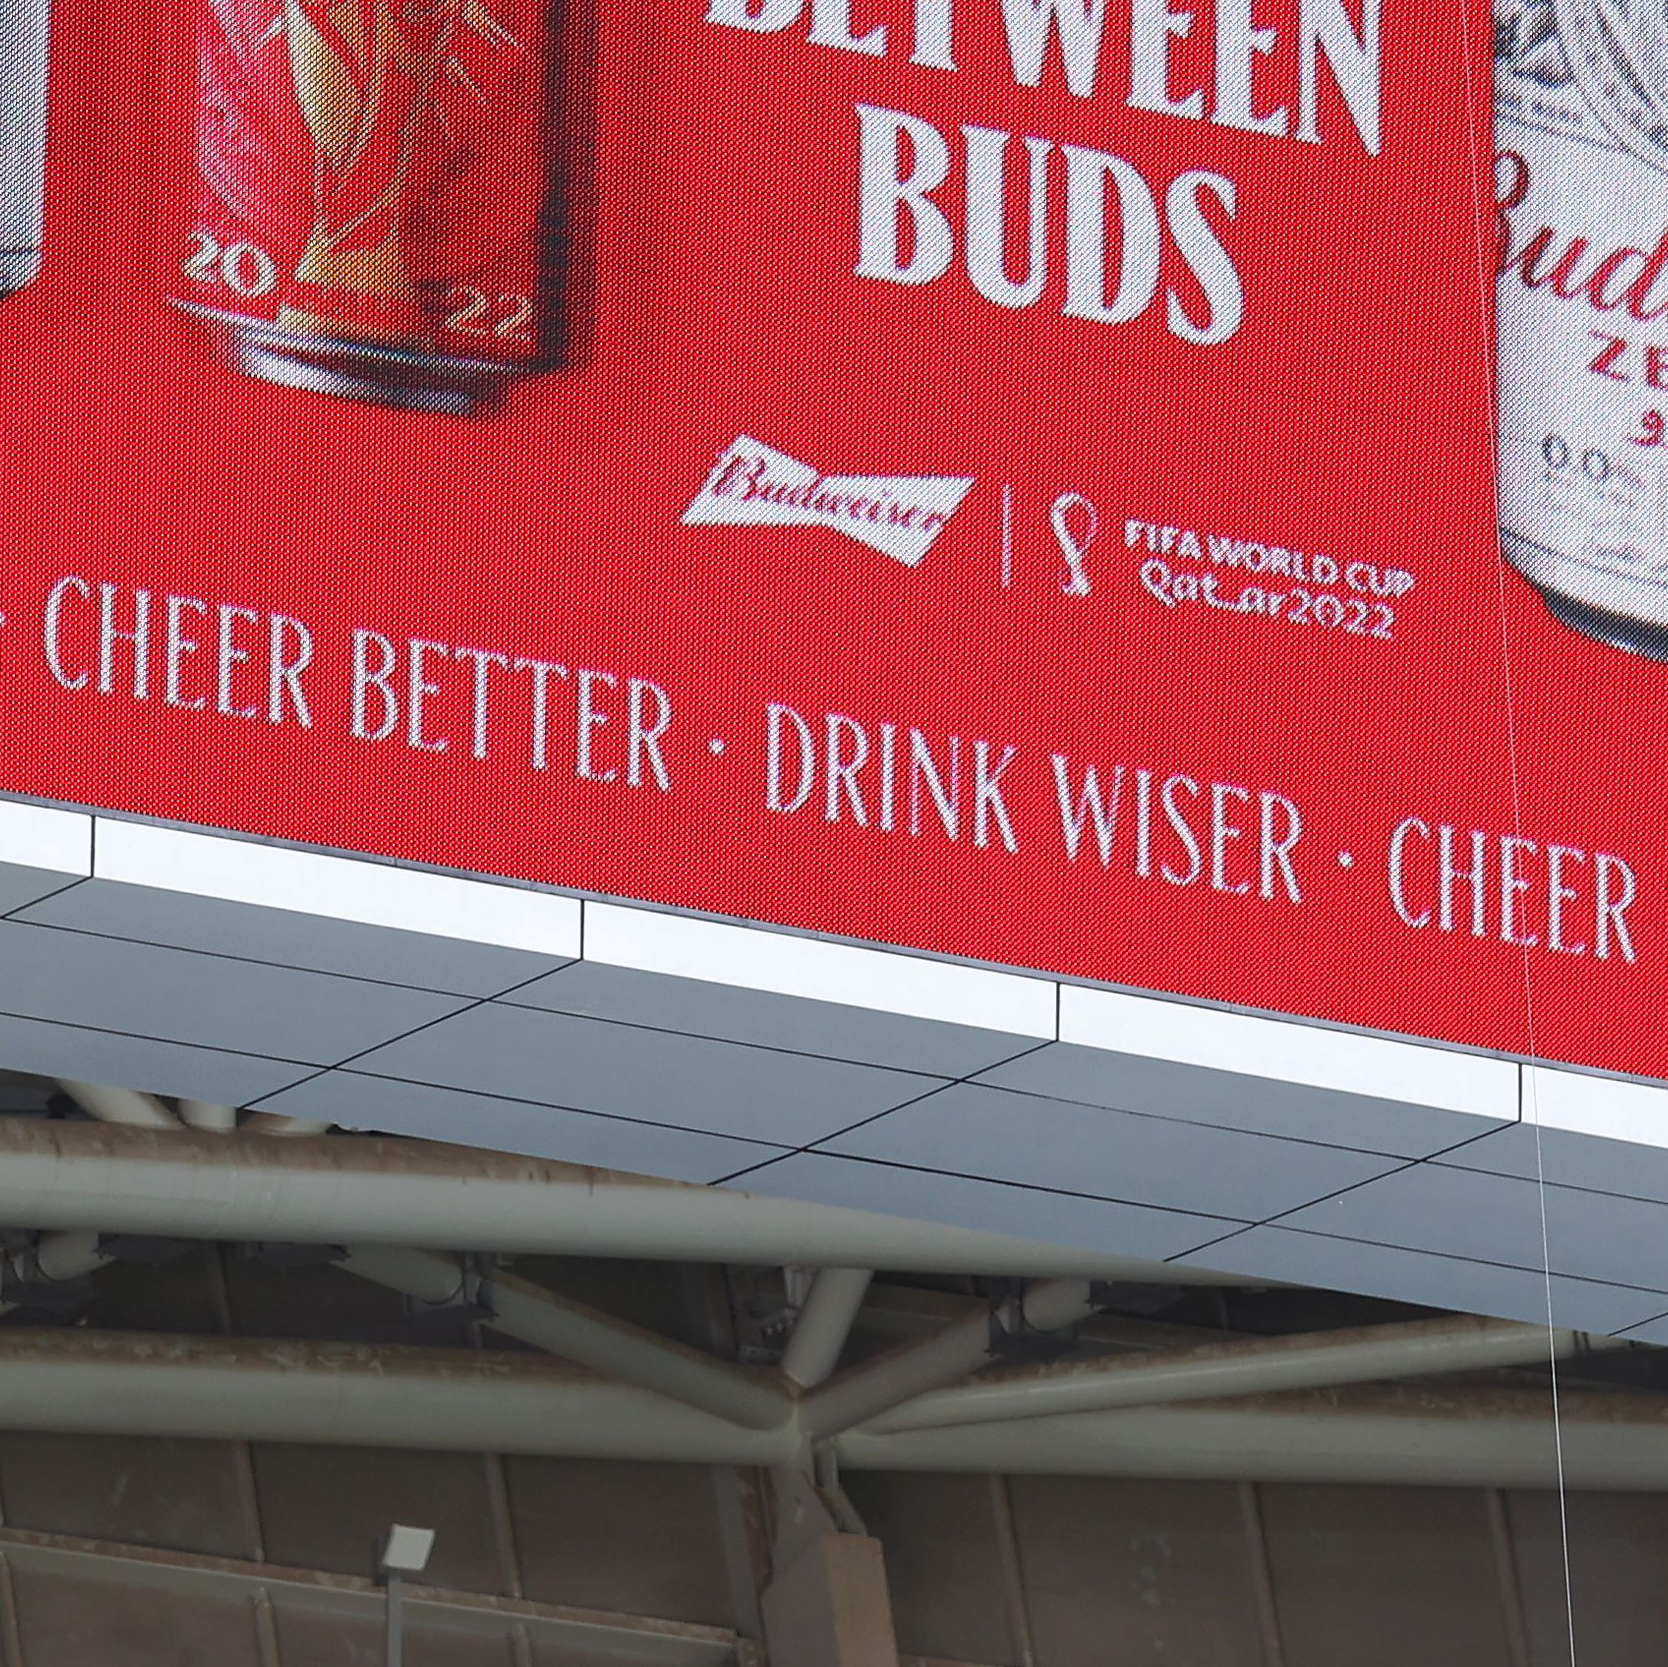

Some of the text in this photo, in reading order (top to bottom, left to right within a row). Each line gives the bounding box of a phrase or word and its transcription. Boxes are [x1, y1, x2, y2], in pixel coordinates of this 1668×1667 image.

[852, 101, 1246, 348] BUDS
[180, 230, 535, 343] 20 22
[710, 450, 945, 533] Budweiser
[1125, 519, 1417, 598] FIFA WORLD CUP
[42, 575, 315, 730] CHEER
[349, 627, 673, 793] BETTER
[764, 701, 1020, 855] DRINK
[1049, 752, 1304, 905] WISER
[1386, 816, 1638, 965] CHEER
